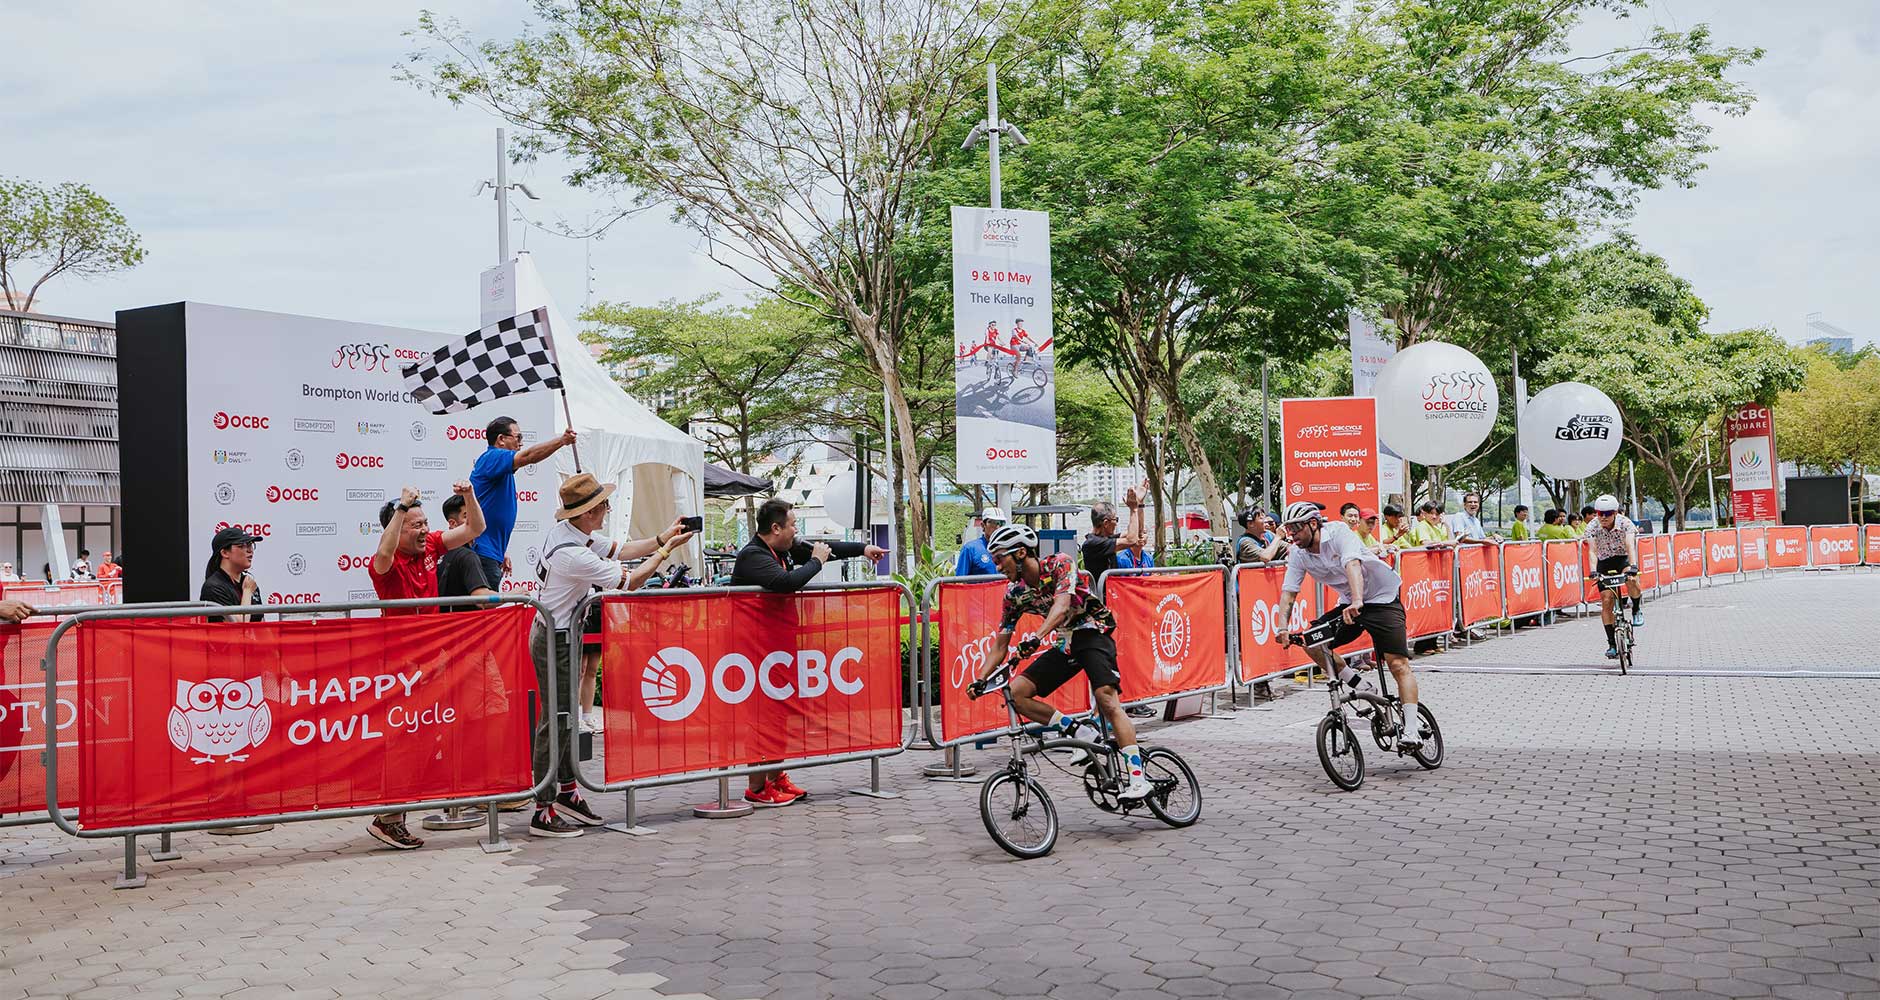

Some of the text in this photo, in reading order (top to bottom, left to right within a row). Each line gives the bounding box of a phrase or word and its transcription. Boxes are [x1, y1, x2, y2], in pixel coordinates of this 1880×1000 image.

[971, 270, 1032, 285] 9 & 10 May
[970, 292, 1034, 307] The Kallang
[394, 348, 420, 361] OCBC
[302, 383, 362, 402] Brompton
[364, 388, 399, 403] World
[1424, 401, 1488, 412] OCBC CYCLE
[230, 415, 270, 430] OCBC
[1557, 427, 1607, 441] CYCLE
[998, 449, 1028, 459] OCBC
[1294, 448, 1368, 460] Brompton World
[350, 455, 384, 468] OCBC
[1299, 458, 1363, 470] Championship
[282, 488, 319, 501] OCBC
[1830, 539, 1854, 553] OCBC
[1311, 631, 1324, 642] 156
[712, 646, 865, 704] OCBC
[290, 669, 422, 707] HAPPY
[288, 704, 457, 746] OWL Cycle
